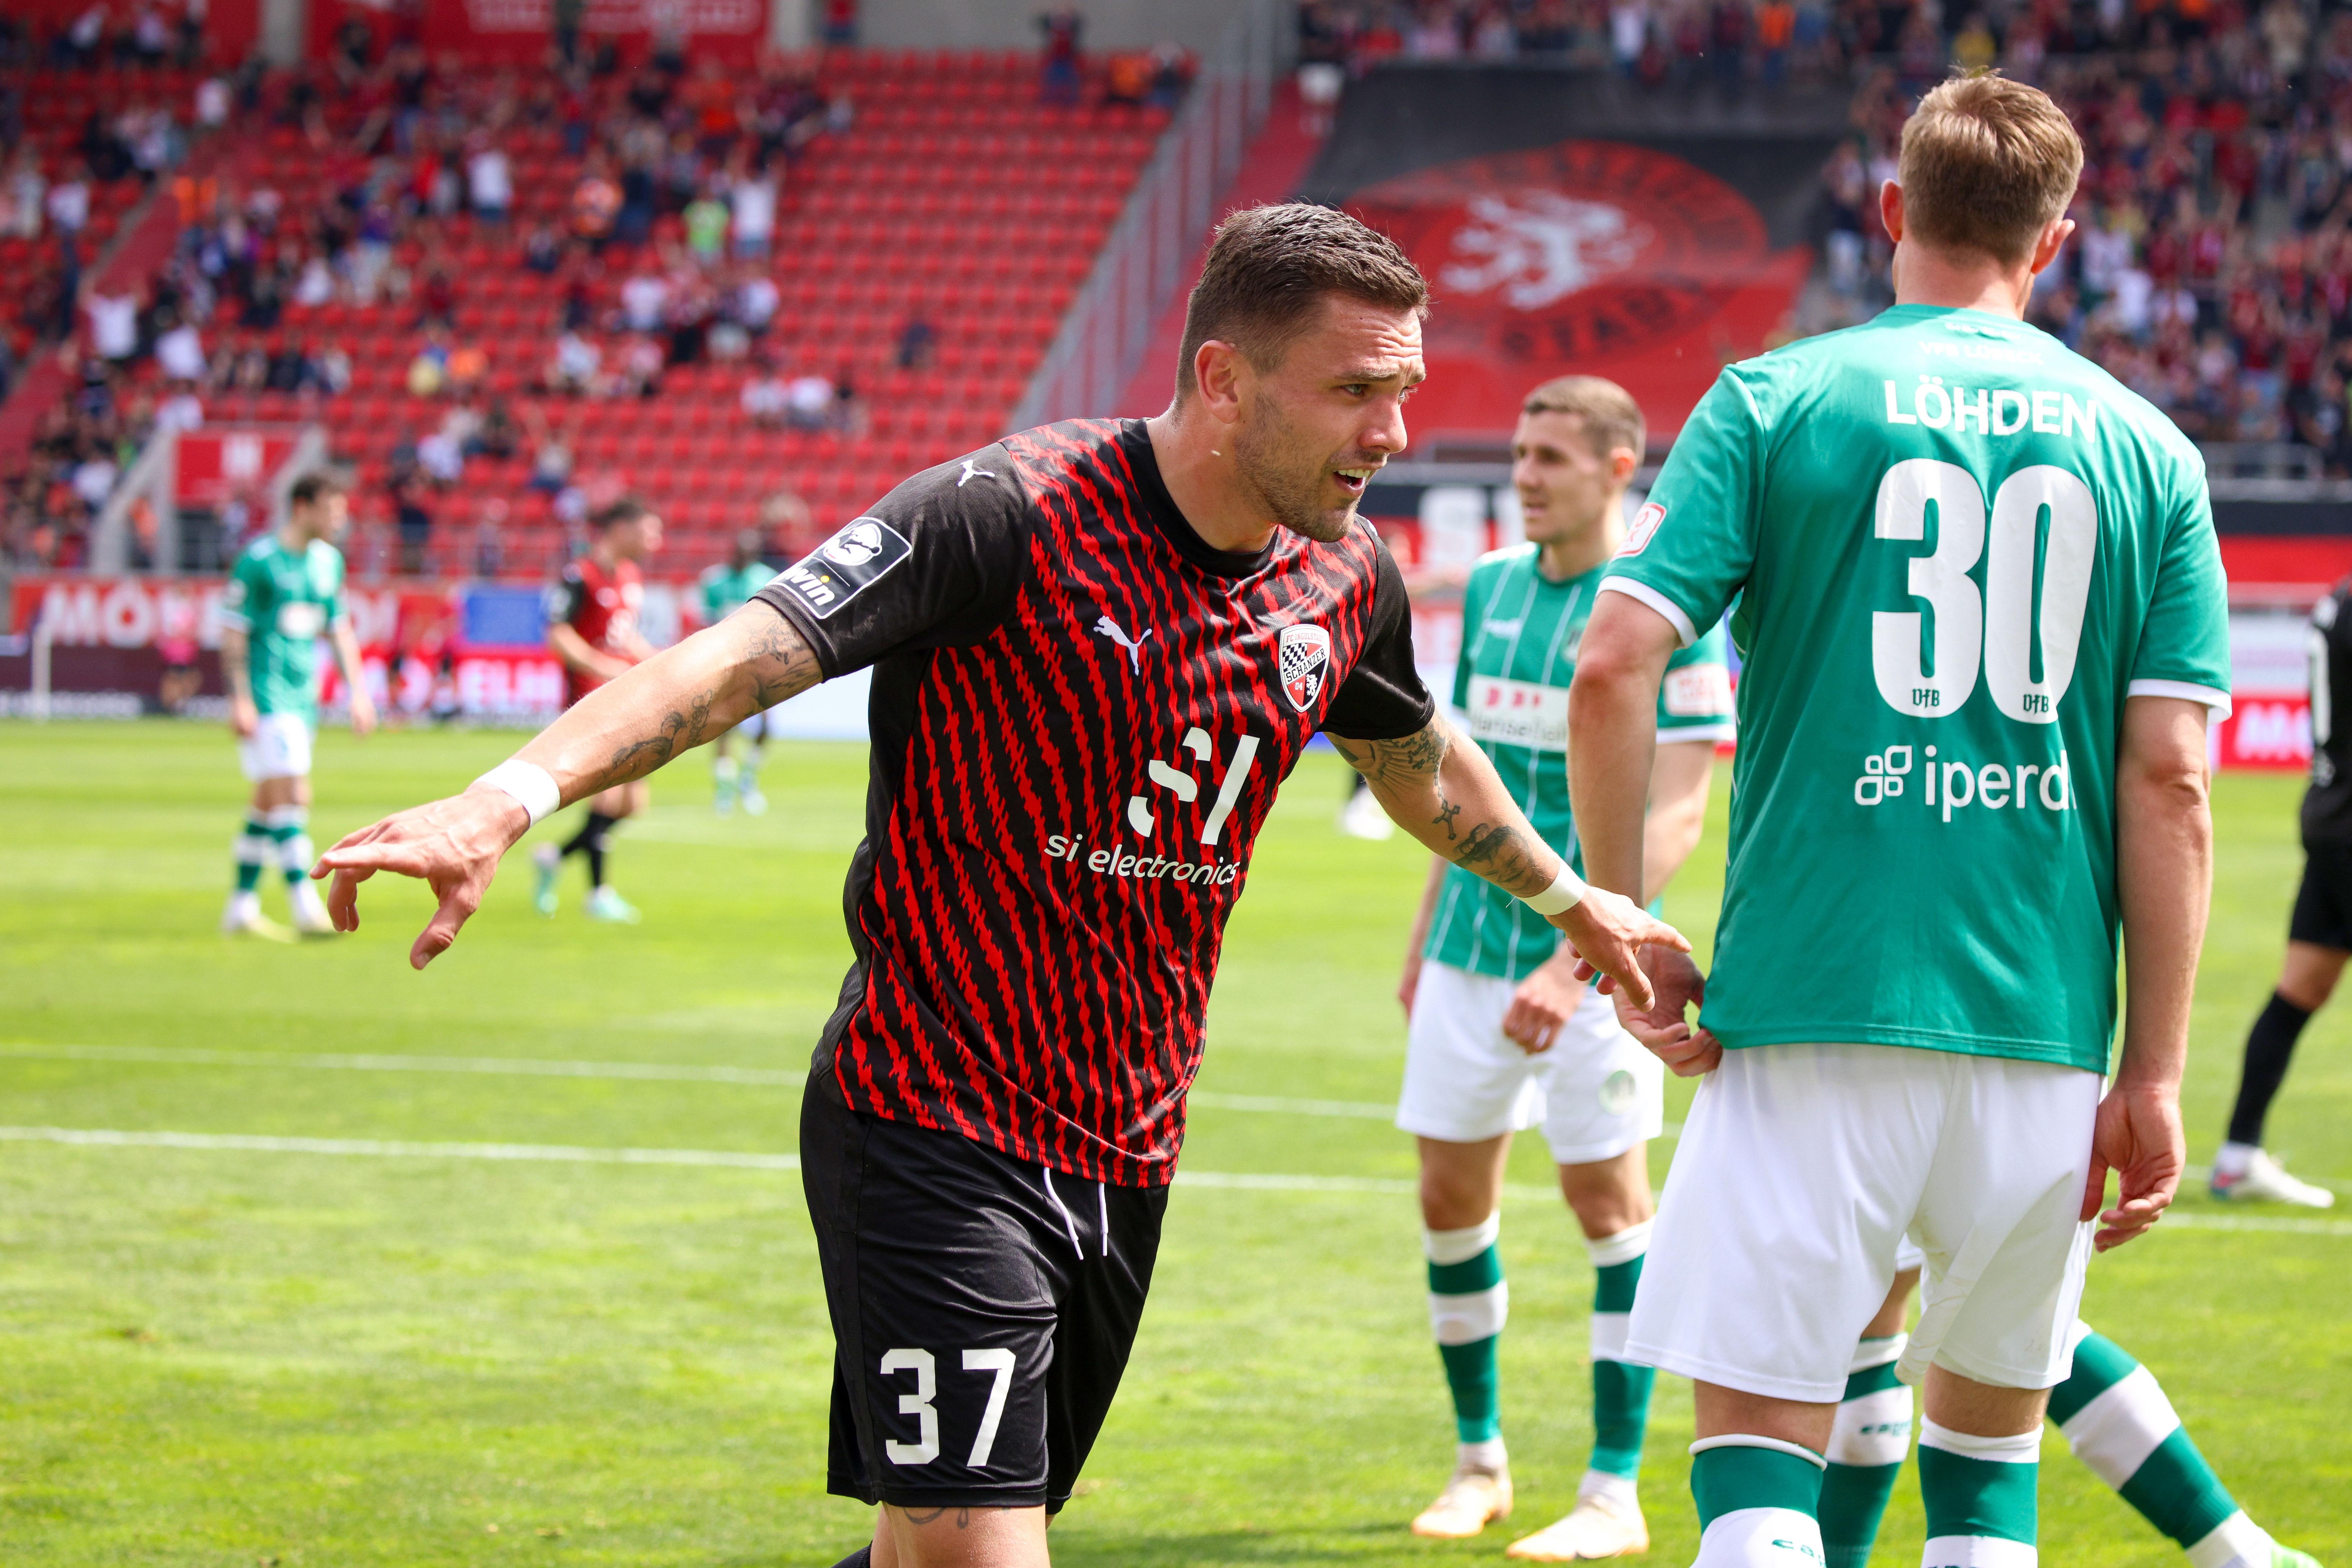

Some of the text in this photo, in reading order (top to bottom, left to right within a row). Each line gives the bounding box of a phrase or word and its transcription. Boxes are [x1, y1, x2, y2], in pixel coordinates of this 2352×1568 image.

[1885, 374, 2097, 443] LÖHDEN
[1872, 458, 2098, 724] 30
[1286, 648, 1326, 682] SCHANZER
[1295, 682, 1303, 691] 04
[1912, 688, 1940, 708] VfB
[2023, 694, 2049, 715] VfB
[1044, 834, 1240, 885] si electronics
[880, 1348, 1016, 1467] 37
